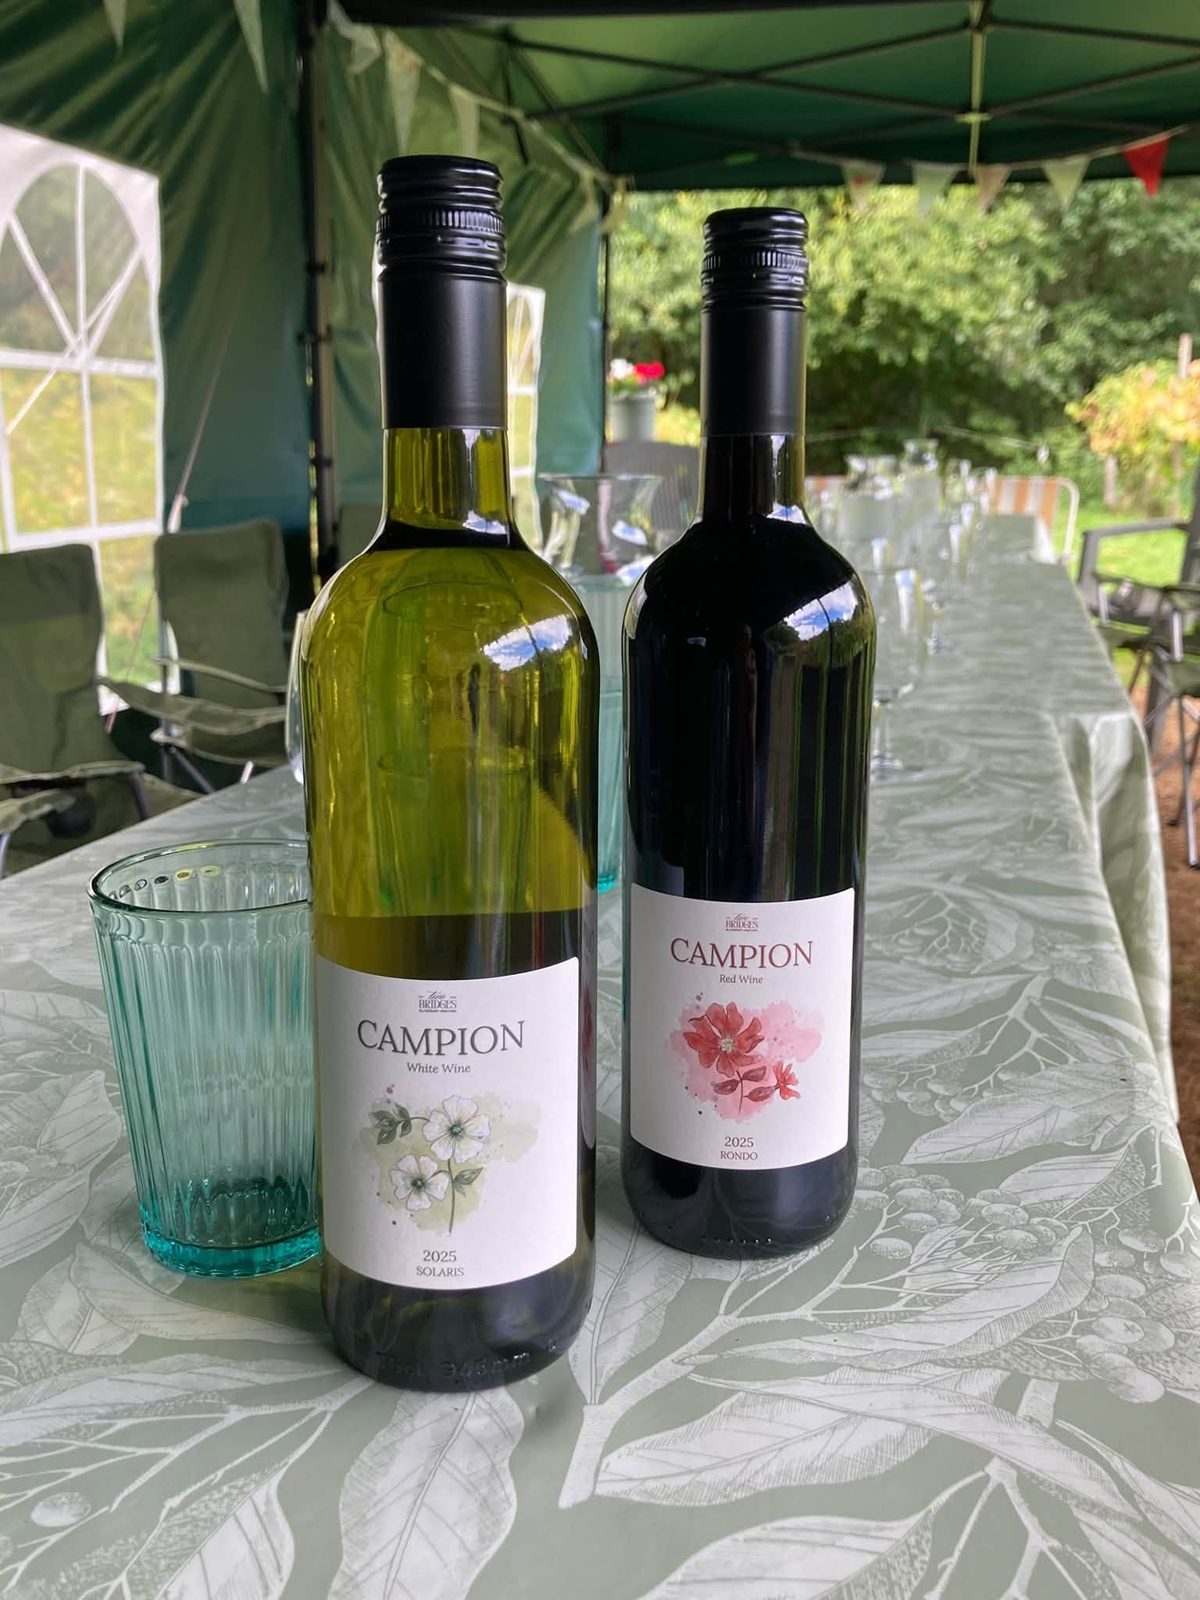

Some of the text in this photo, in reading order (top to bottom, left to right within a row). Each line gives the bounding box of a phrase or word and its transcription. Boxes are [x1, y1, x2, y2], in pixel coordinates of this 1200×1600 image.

[725, 920, 759, 928] BRIDGES
[670, 937, 813, 969] CAMPION
[719, 974, 763, 985] Red Wine
[418, 1000, 457, 1009] BRIDGES
[357, 1019, 525, 1056] CAMPION
[406, 1062, 471, 1074] White Wine
[724, 1136, 754, 1148] 2025
[720, 1150, 758, 1161] RONDO
[423, 1249, 457, 1263] 2025
[416, 1265, 465, 1277] SOLARIS
